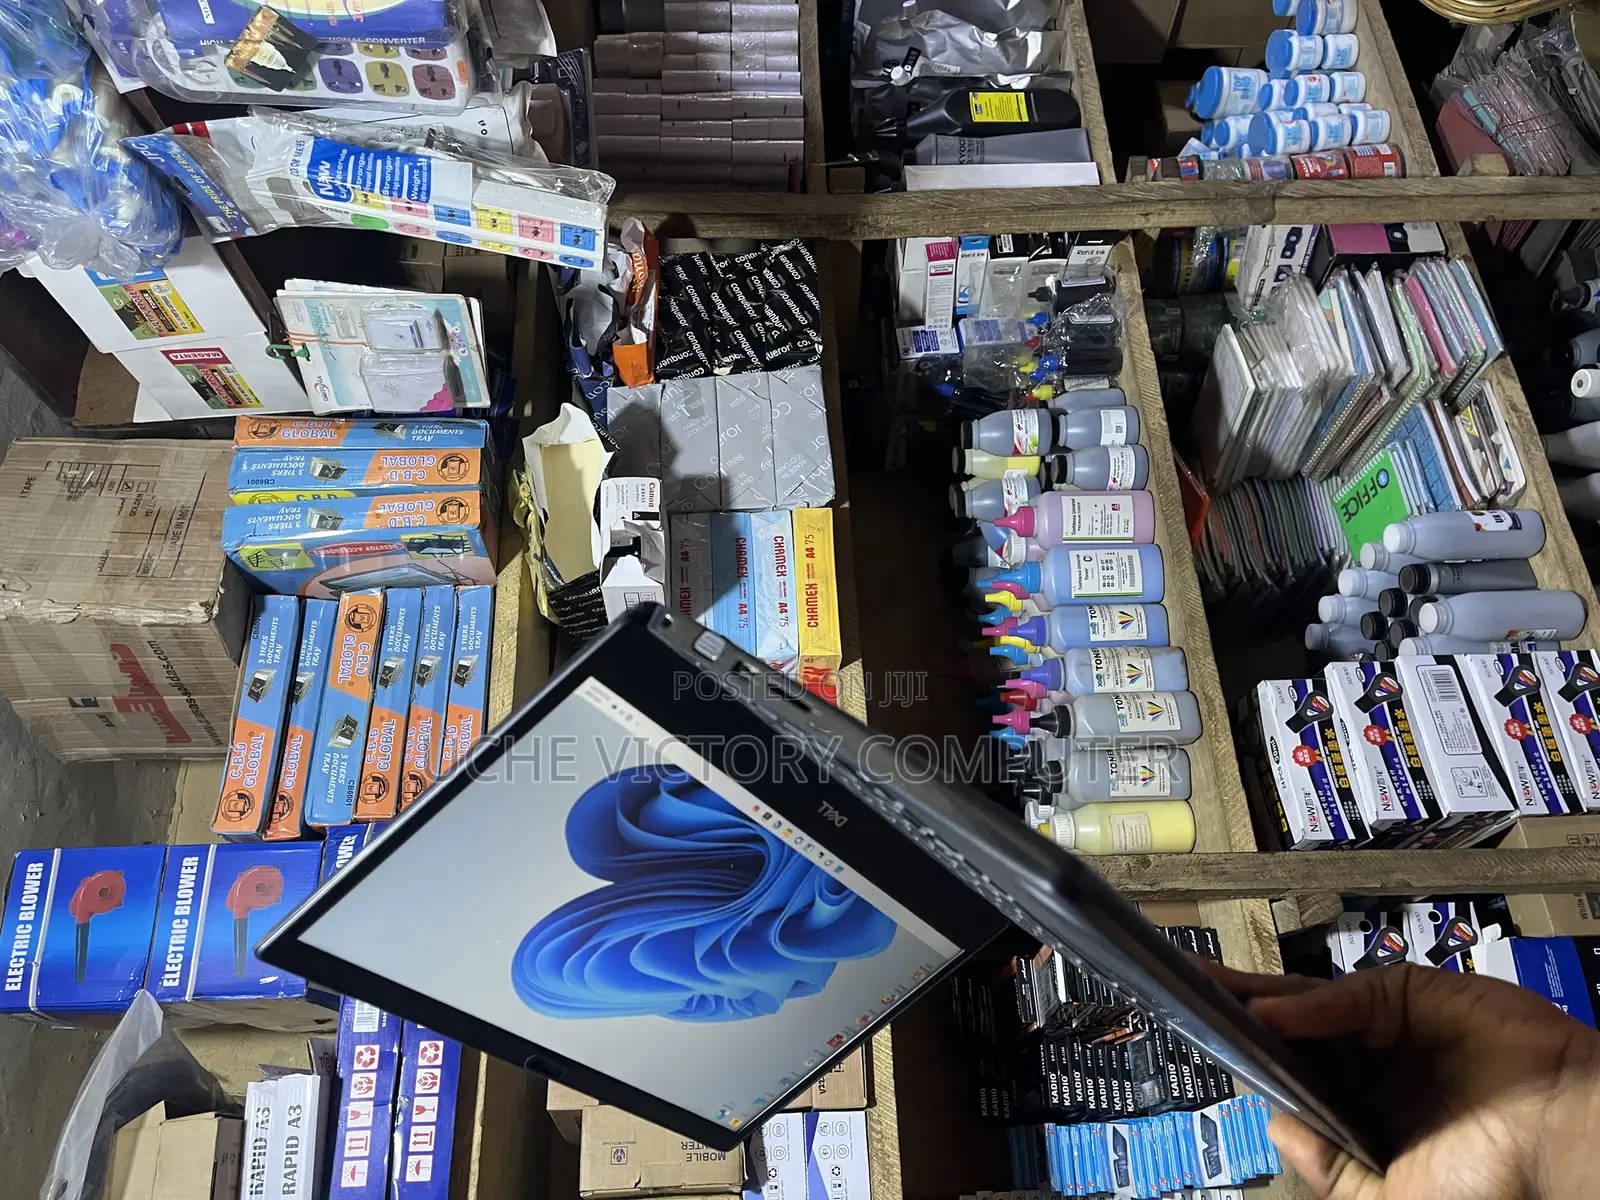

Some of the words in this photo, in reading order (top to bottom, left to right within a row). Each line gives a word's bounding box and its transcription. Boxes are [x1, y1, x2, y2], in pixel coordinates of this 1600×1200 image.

[132, 142, 165, 163] JPC
[383, 155, 392, 195] Stronger
[411, 169, 420, 200] Weight
[686, 284, 710, 321] conqueror
[711, 292, 737, 326] conqueror
[731, 282, 757, 319] conqueror
[780, 290, 807, 325] conqueror
[171, 352, 221, 360] MAGENTA
[734, 330, 761, 366] conqueror
[280, 429, 337, 440] GLOBAL
[250, 461, 305, 470] DOCUMENTS
[271, 469, 296, 477] TIERS
[380, 456, 437, 466] GLOBAL
[389, 470, 427, 480] C.B.D
[129, 493, 144, 517] GOLDEN
[379, 501, 435, 512] GLOBAL
[1340, 468, 1389, 524] OFFICE
[247, 513, 301, 525] DOCUMENTS
[267, 522, 293, 530] TIERS
[683, 537, 690, 550] 75
[805, 535, 815, 546] 75
[807, 547, 815, 558] A4
[736, 537, 749, 578] CHAMEX
[773, 535, 787, 577] CHAMEX
[738, 603, 748, 615] A4
[778, 602, 788, 614] A4
[807, 583, 819, 628] CHAMEX
[394, 607, 406, 652] DOCUMENTS
[423, 623, 432, 644] TIERS
[429, 605, 441, 651] DOCUMENTS
[461, 624, 469, 644] TIERS
[467, 606, 477, 651] DOCUMENTS
[739, 617, 749, 629] 75
[779, 616, 788, 627] 75
[259, 635, 268, 657] TIERS
[265, 616, 279, 664] DOCUMENTS
[273, 643, 283, 664] TRAY
[304, 620, 318, 667] DOCUMENTS
[402, 633, 412, 652] TRAY
[437, 632, 447, 651] TRAY
[474, 631, 483, 651] TRAY
[312, 646, 322, 667] TRAY
[337, 633, 356, 683] GLOBAL
[356, 642, 370, 677] C.B.D
[365, 728, 379, 764] C.B.D
[377, 718, 396, 772] GLOBAL
[405, 727, 417, 763] C.B.D
[414, 717, 433, 769] GLOBAL
[443, 724, 457, 761] C.B.D
[230, 742, 248, 780] C.B.D
[244, 733, 265, 788] GLOBAL
[283, 734, 304, 790] GLOBAL
[320, 753, 331, 774] TRAY
[338, 760, 348, 785] TIERS
[326, 753, 341, 804] DOCUMENTS
[345, 779, 355, 807] CB6001
[175, 856, 199, 916] BLOWER
[5, 923, 33, 991] ELECTRIC
[22, 862, 44, 921] BLOWER
[162, 916, 189, 987] ELECTRIC
[1050, 1073, 1059, 1103] KADIO
[1061, 1076, 1071, 1105] KADIO
[1074, 1072, 1083, 1101] KADIO
[1087, 1079, 1095, 1109] KADIO
[1099, 1078, 1108, 1108] KADIO
[1112, 1080, 1121, 1110] KADIO
[1168, 1064, 1180, 1097] KADIO
[1182, 1066, 1194, 1098] KADIO
[1124, 1081, 1134, 1112] KADIO
[288, 1104, 302, 1129] A3
[281, 1135, 300, 1195] RAPID
[686, 1151, 726, 1162] MOBILE
